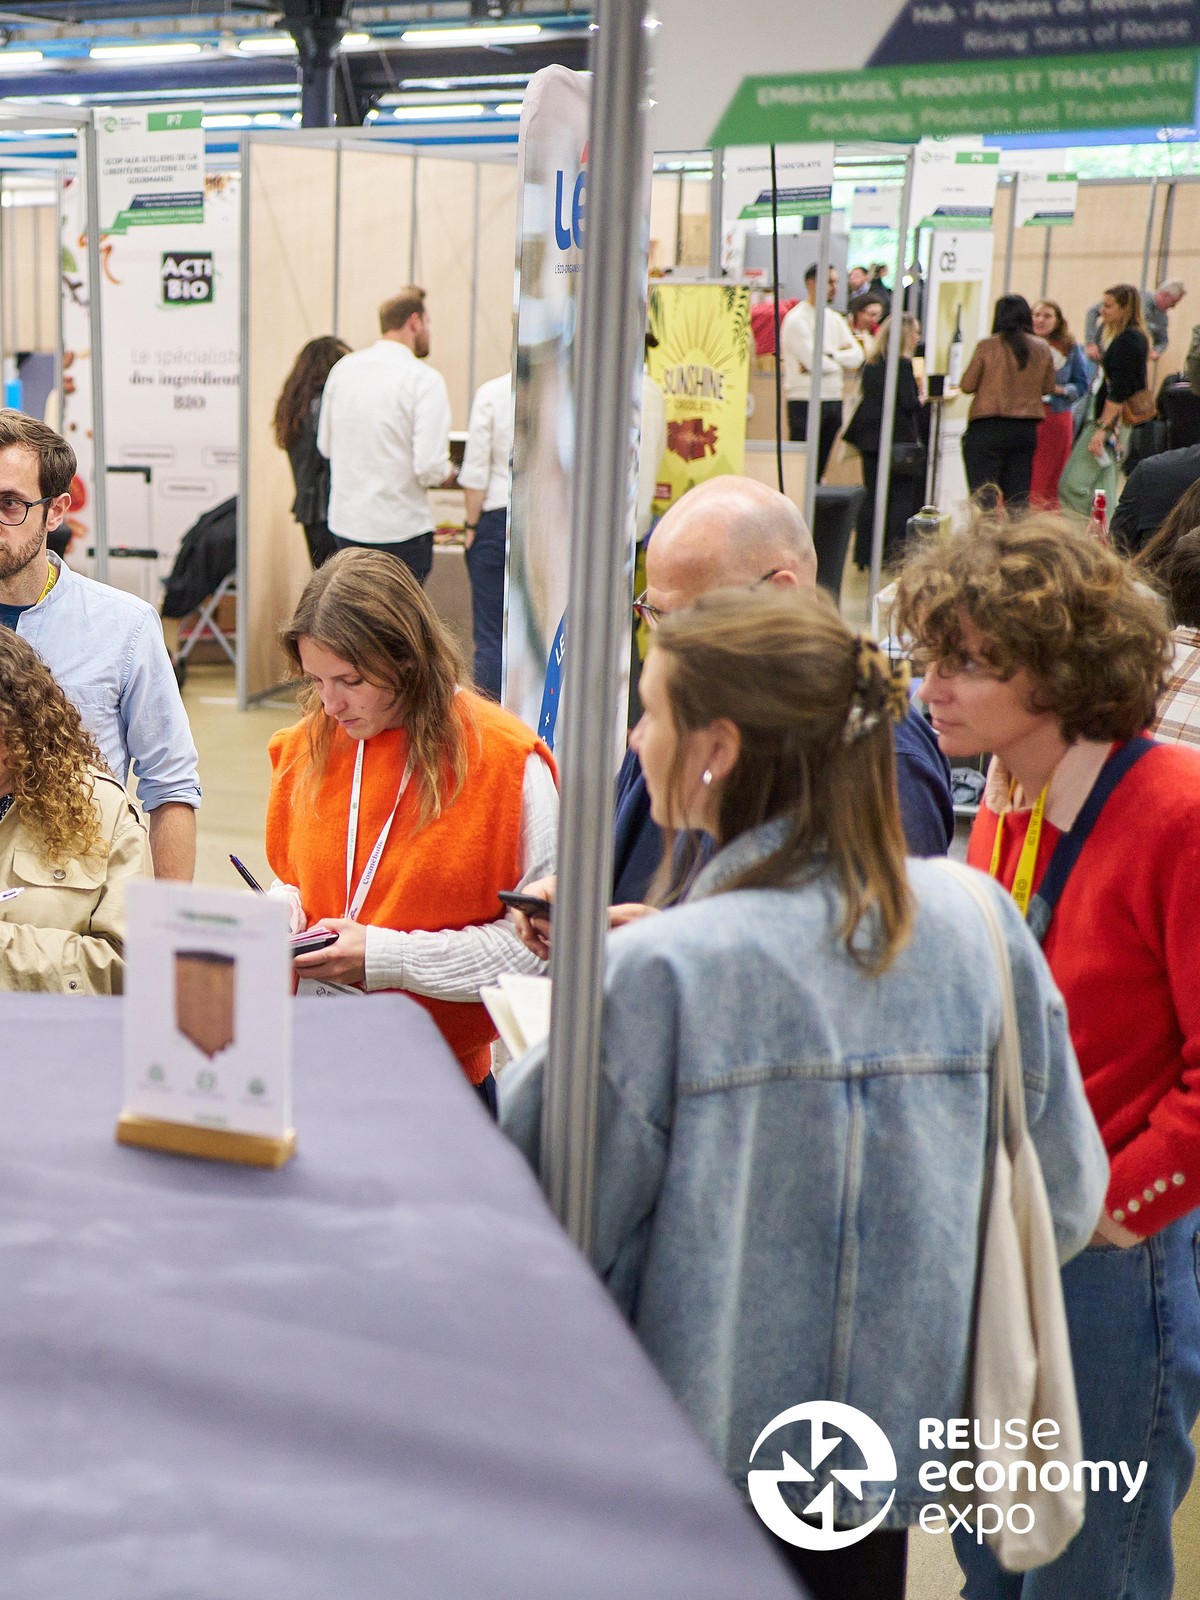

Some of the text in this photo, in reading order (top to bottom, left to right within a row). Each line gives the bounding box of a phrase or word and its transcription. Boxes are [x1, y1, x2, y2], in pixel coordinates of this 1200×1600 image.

[963, 29, 1028, 53] Rising
[1032, 24, 1088, 46] Stars
[1093, 20, 1117, 42] of
[1015, 71, 1040, 92] ET
[167, 280, 209, 300] BIO
[664, 364, 724, 400] SUNSHINE
[363, 839, 383, 885] Cosmébulle
